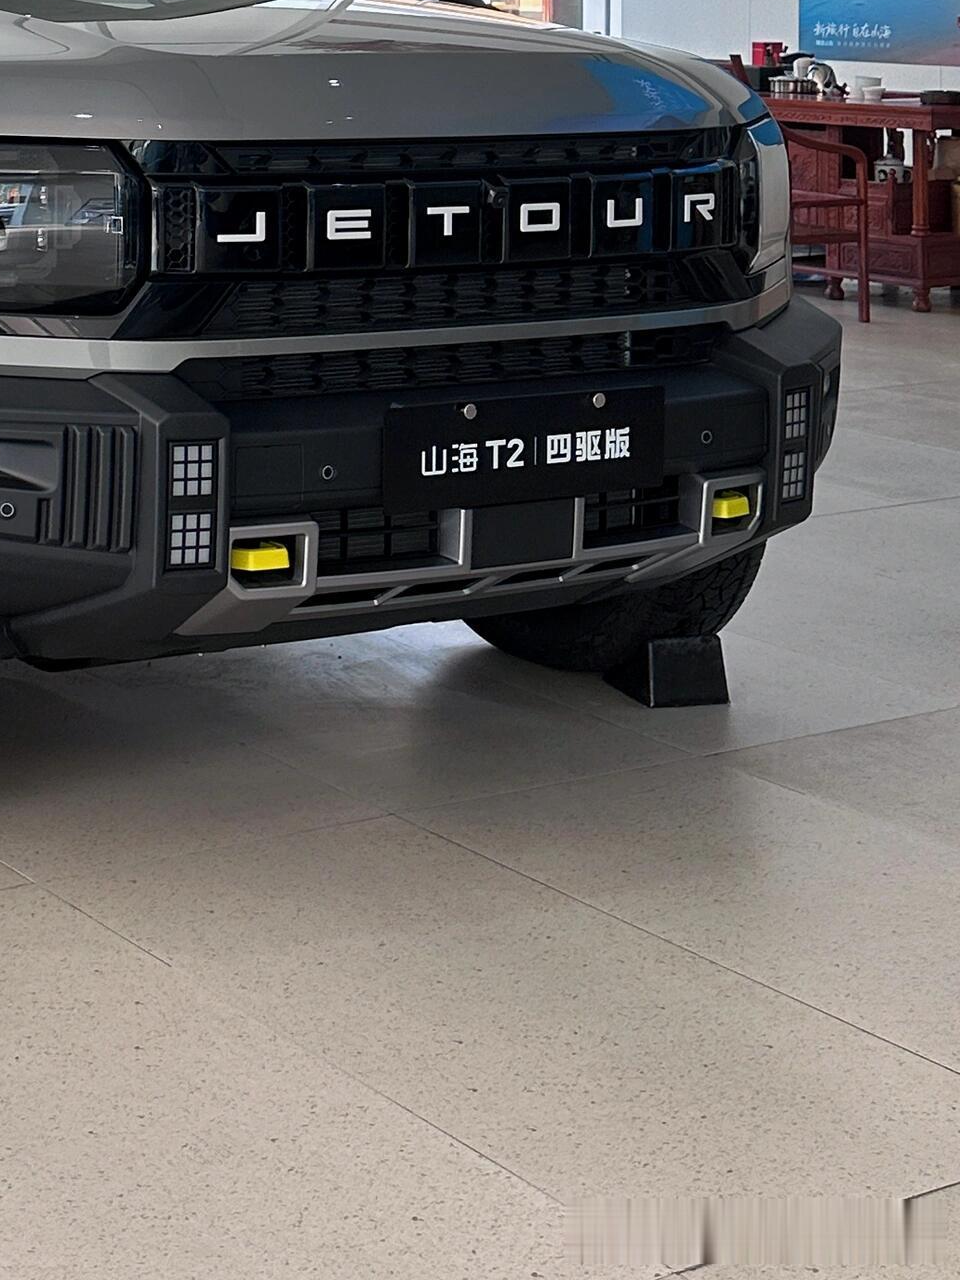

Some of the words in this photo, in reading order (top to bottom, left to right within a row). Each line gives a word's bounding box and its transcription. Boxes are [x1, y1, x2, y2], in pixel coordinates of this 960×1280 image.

[216, 192, 715, 243] JETOUR
[546, 426, 631, 465] 四驱版
